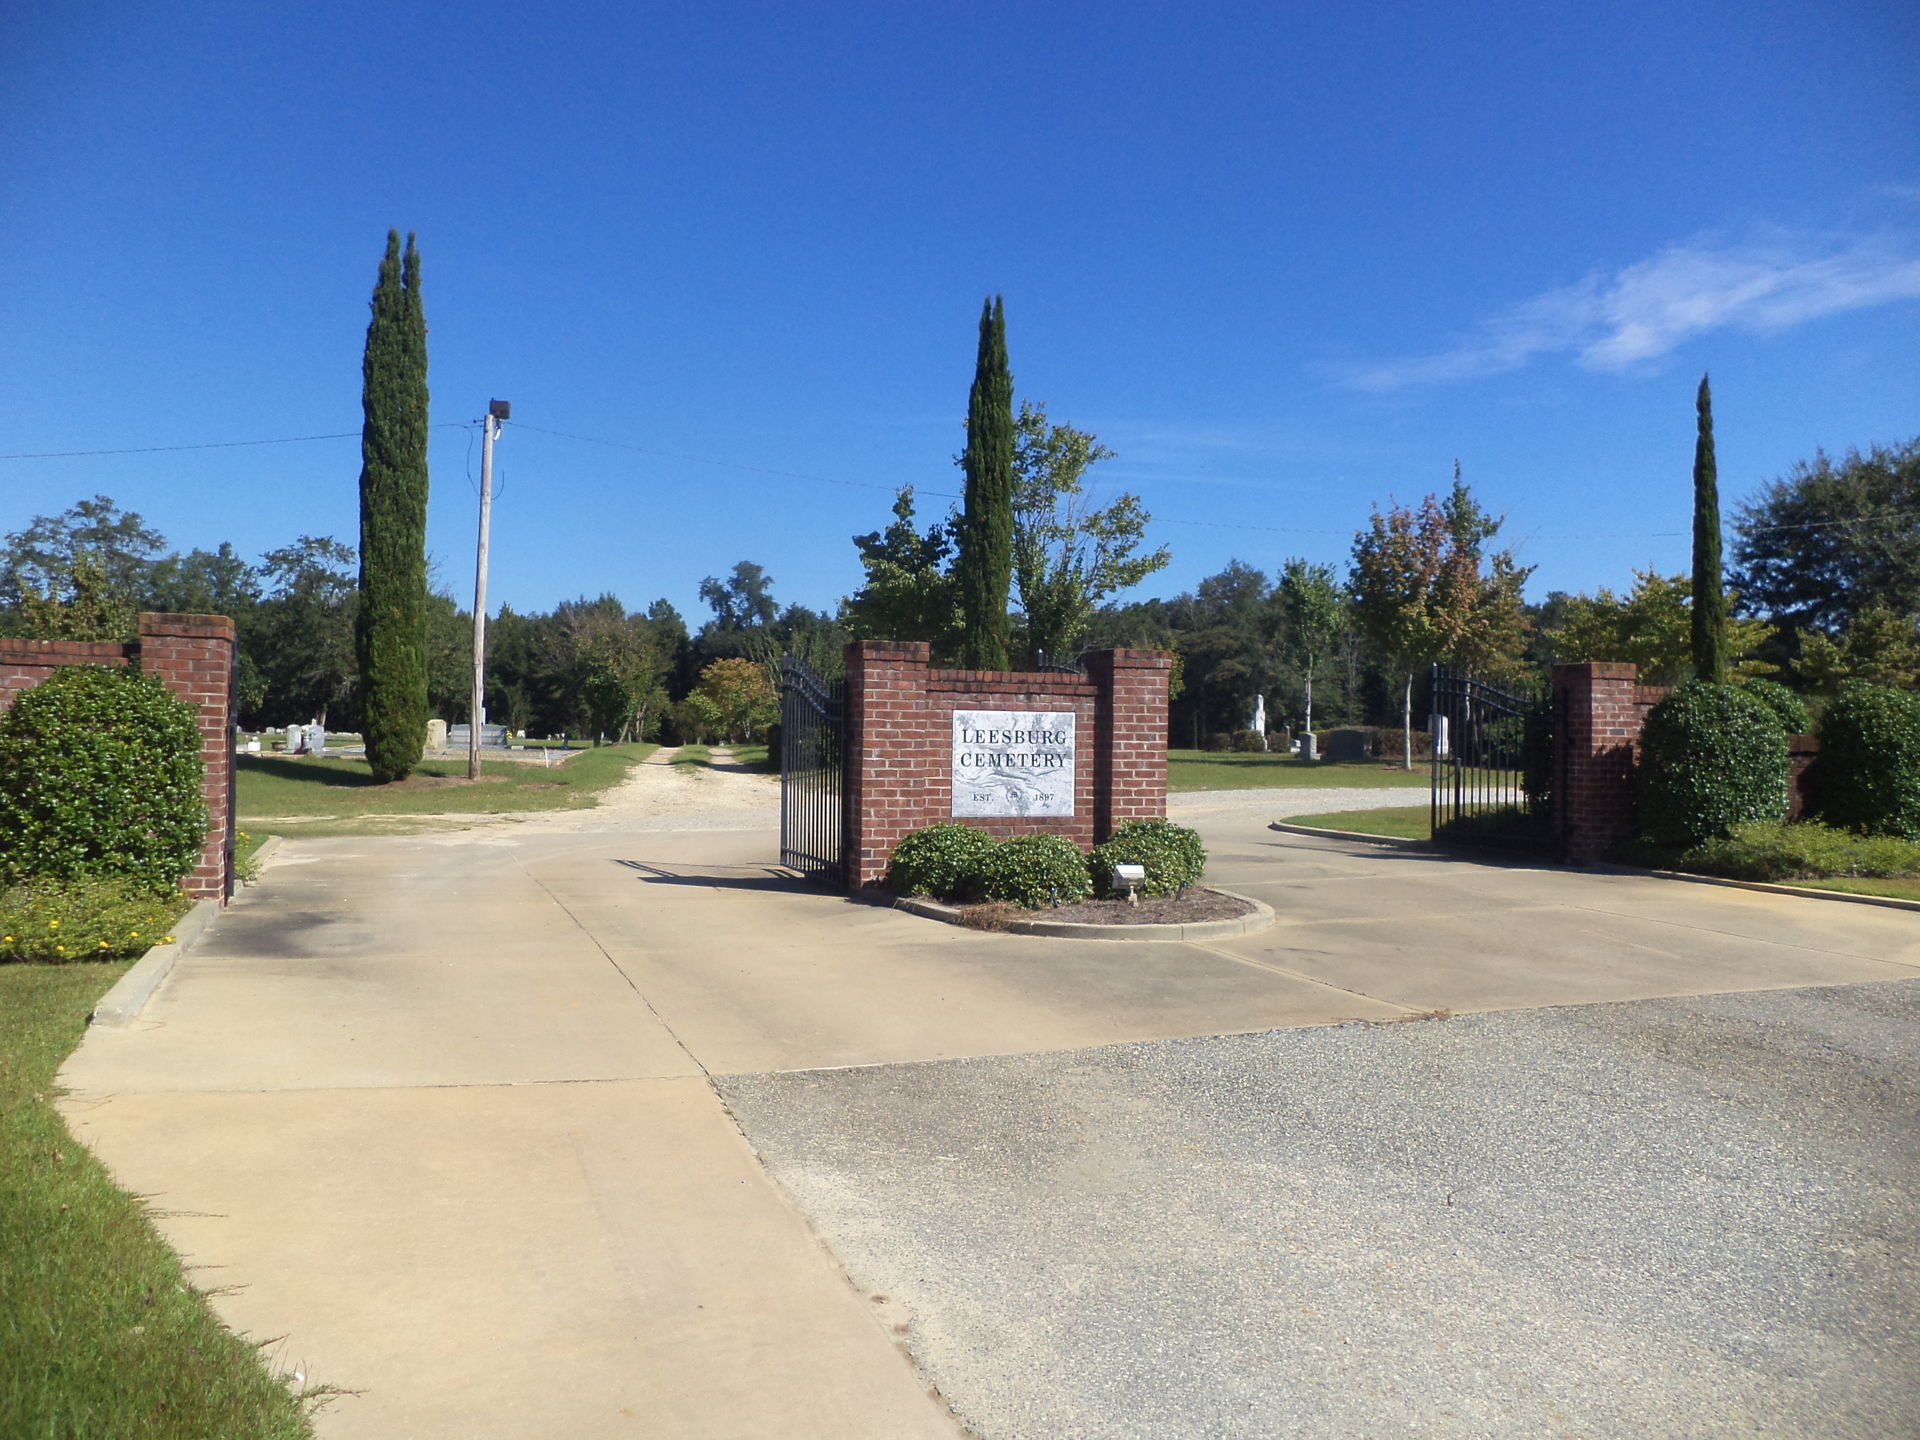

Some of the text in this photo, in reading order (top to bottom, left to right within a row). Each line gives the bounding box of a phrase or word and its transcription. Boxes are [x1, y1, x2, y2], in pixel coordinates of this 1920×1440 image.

[962, 729, 1066, 744] LEESBURG
[961, 753, 1067, 767] CEMETERY
[973, 793, 1055, 801] EST. 1897
